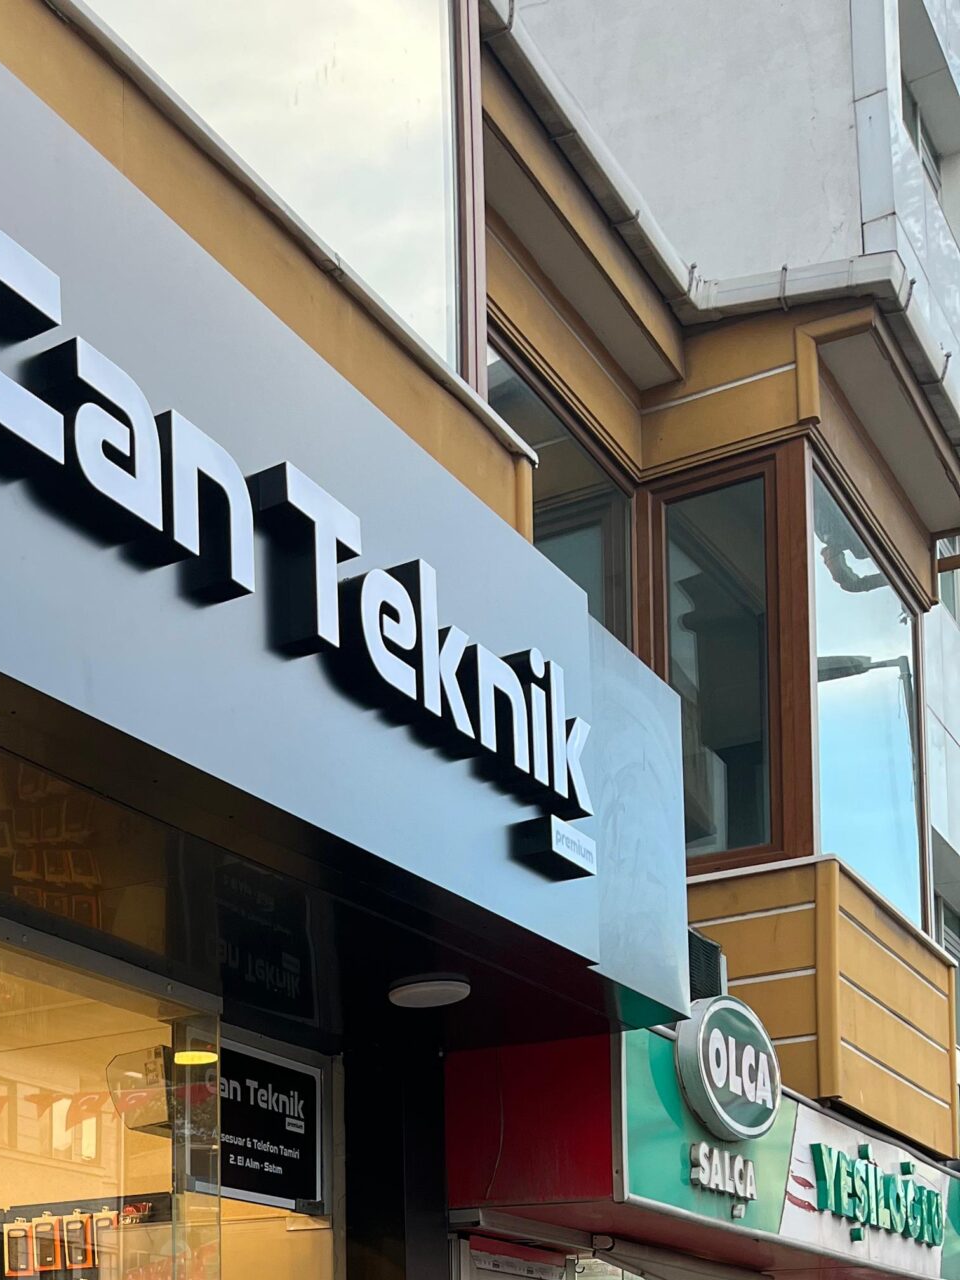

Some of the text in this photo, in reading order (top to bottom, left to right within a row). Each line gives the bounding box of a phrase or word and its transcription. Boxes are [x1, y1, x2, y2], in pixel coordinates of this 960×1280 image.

[284, 460, 594, 818] Teknik
[555, 829, 594, 865] premium
[708, 1027, 774, 1110] OLCA
[245, 1078, 305, 1119] Teknik
[246, 1137, 252, 1147] &
[253, 1138, 279, 1155] Telefon
[279, 1145, 300, 1160] Tamiri
